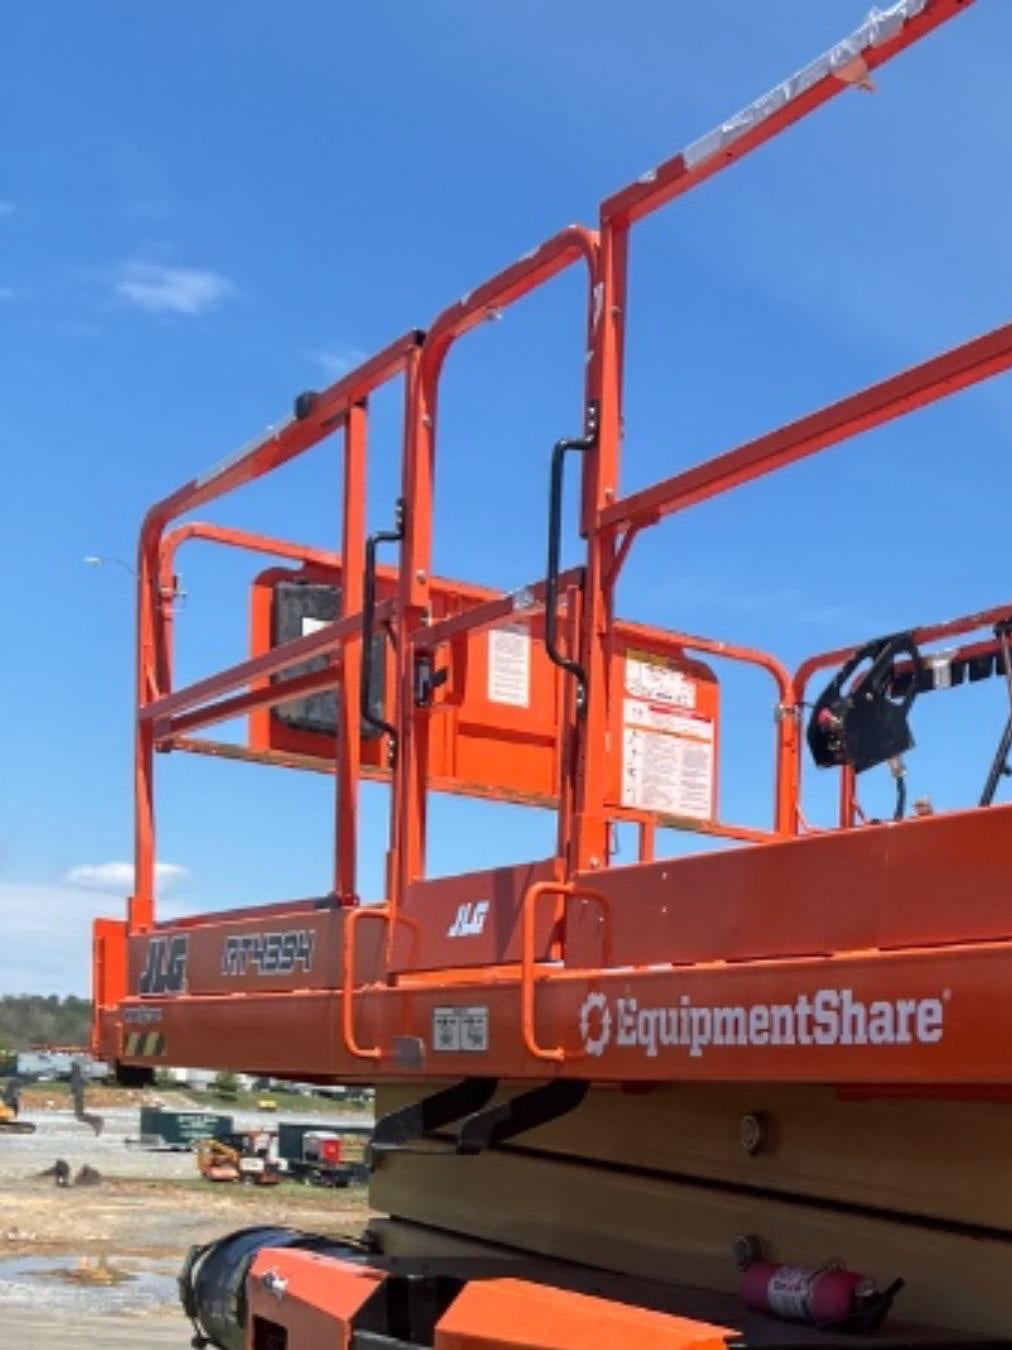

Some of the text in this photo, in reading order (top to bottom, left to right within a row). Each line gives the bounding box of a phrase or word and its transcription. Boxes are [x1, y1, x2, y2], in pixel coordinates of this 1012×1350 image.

[448, 901, 489, 937] JLG
[139, 934, 188, 996] JLG
[617, 988, 943, 1057] EquipmentShare
